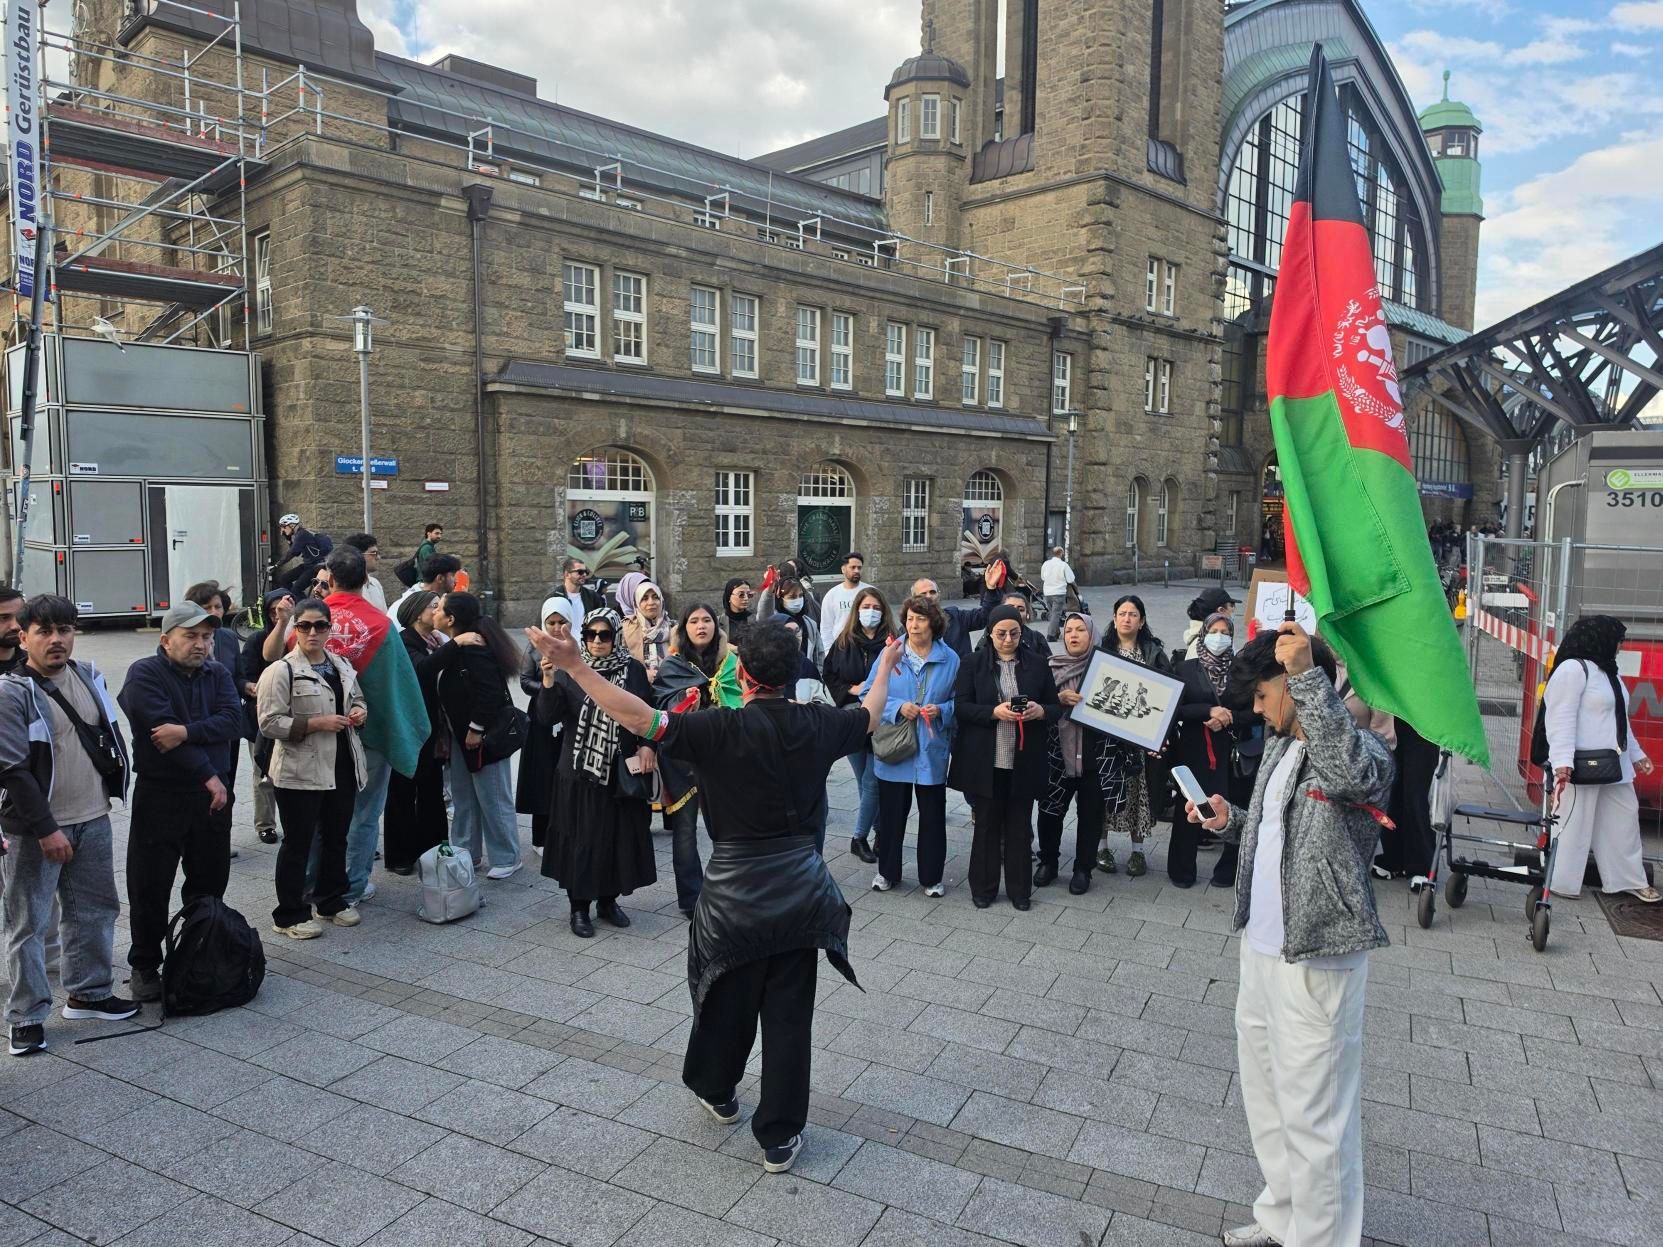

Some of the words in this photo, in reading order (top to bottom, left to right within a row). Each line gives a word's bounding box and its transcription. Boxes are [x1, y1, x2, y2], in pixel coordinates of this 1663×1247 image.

[14, 6, 32, 135] Gerüstbau
[16, 140, 36, 224] NORD
[19, 254, 35, 268] NOR
[337, 457, 397, 467] Glockeneßerwall
[1606, 491, 1663, 508] 3510
